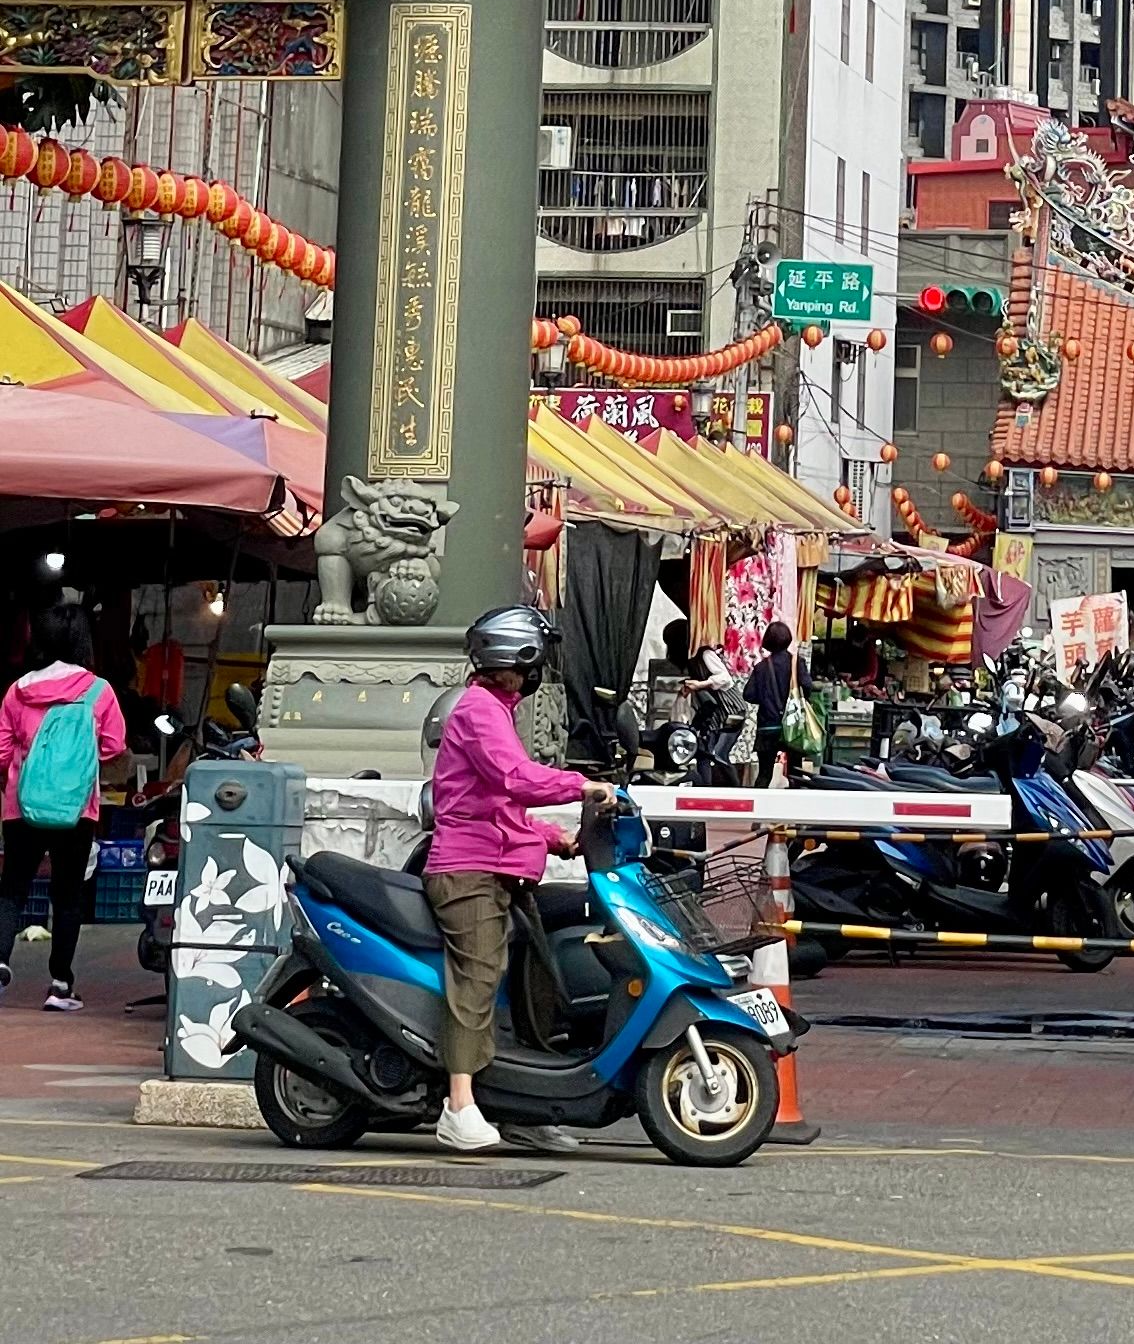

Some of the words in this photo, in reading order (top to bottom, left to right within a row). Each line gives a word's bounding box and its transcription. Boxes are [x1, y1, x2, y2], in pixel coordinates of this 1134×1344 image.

[788, 269, 861, 291] 延平路
[786, 297, 834, 315] Yanping
[839, 301, 860, 314] Rd.
[1061, 610, 1087, 669] 芋頭
[148, 879, 173, 896] PAA
